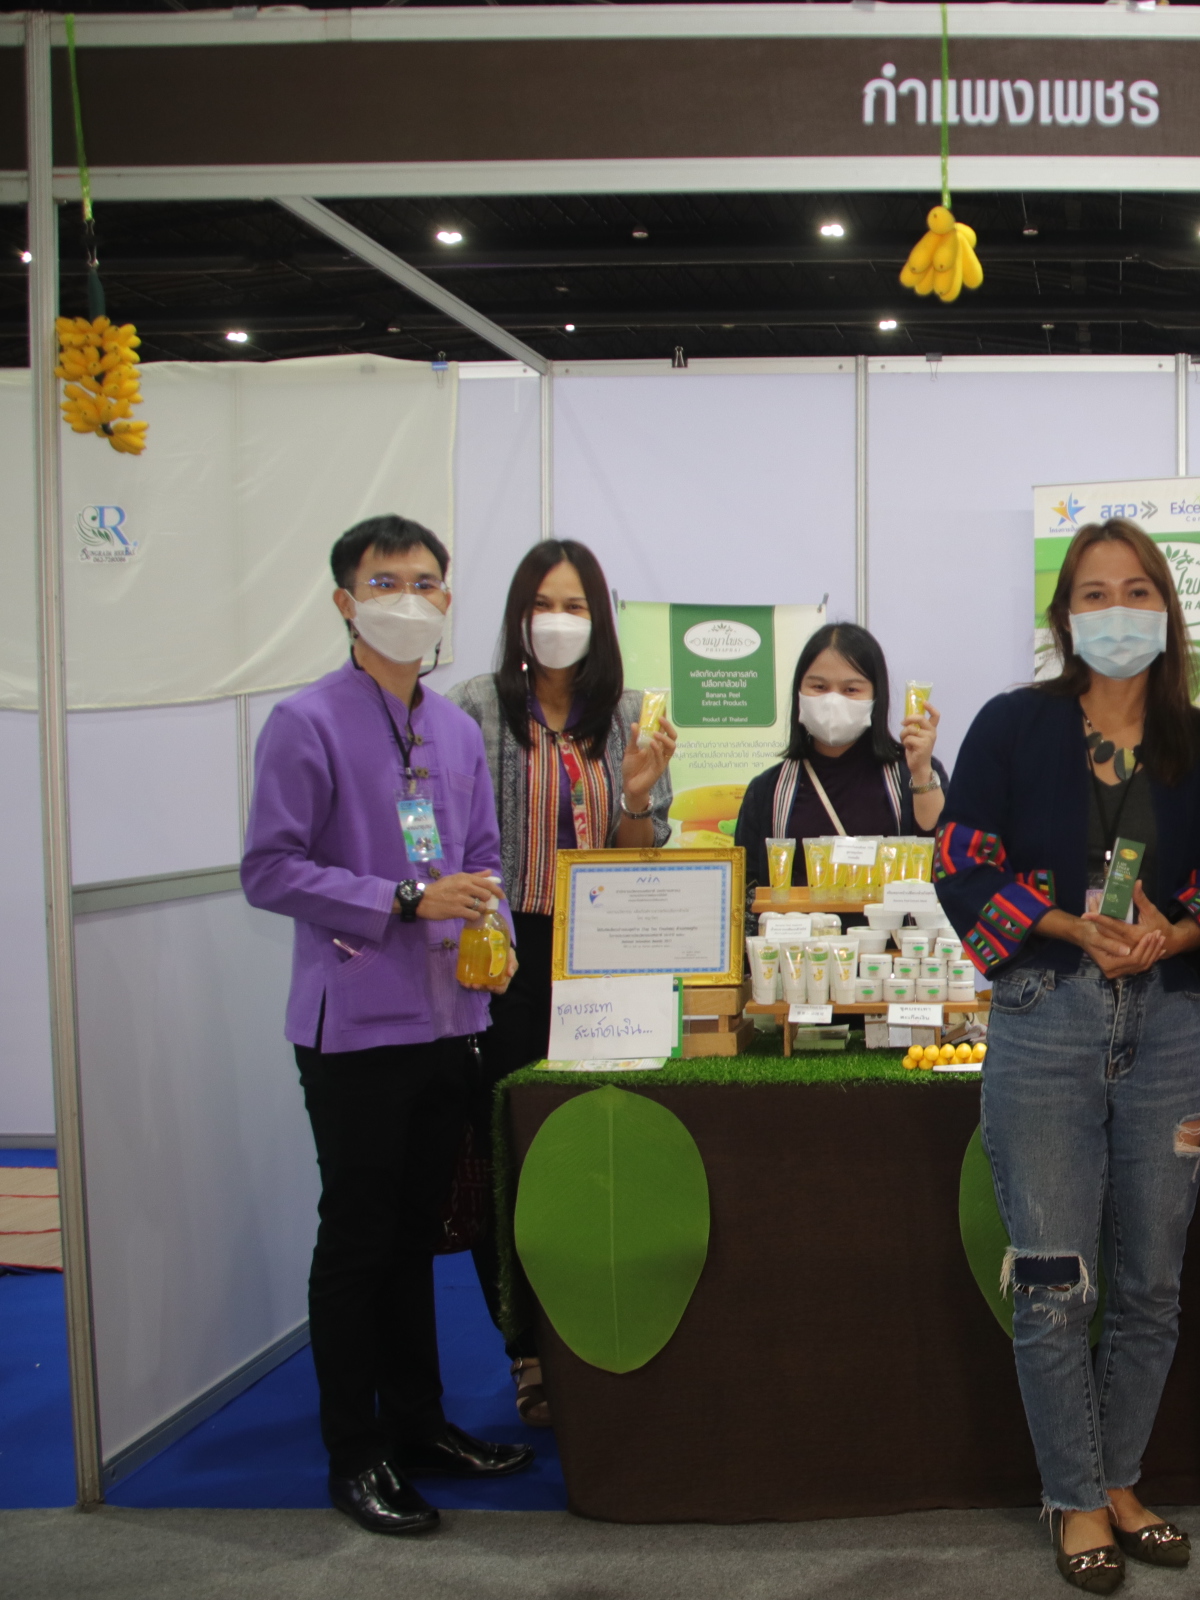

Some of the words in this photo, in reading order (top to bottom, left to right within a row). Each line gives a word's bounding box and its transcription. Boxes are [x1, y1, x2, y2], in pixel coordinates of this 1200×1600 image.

[863, 62, 1159, 125] กำแพงเพชร
[690, 669, 758, 678] ผลิตภัณฑ์จากสารสกัด
[701, 679, 747, 688] เปลือกกล้วยไข่
